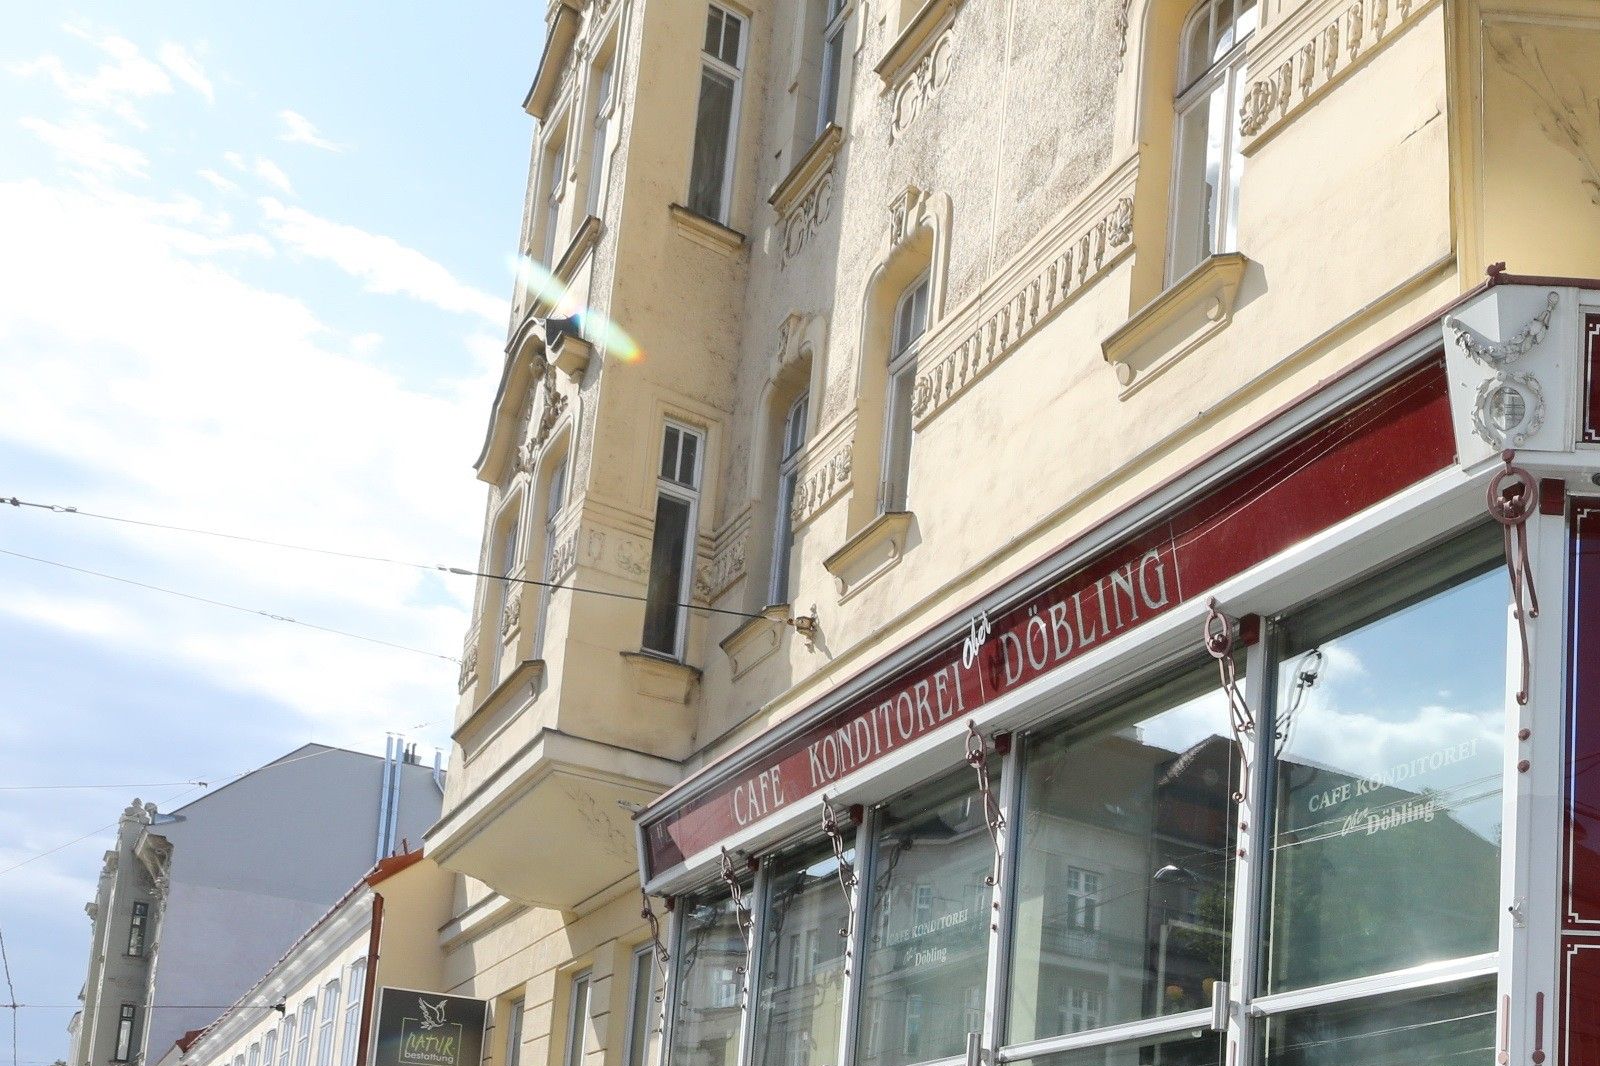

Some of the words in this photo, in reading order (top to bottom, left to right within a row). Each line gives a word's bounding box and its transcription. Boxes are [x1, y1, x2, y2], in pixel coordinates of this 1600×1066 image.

[1000, 548, 1169, 688] DÖBLING
[733, 765, 784, 826] CAFE
[807, 661, 965, 788] KONDITOREI
[1308, 783, 1351, 813] CAFE
[1355, 738, 1479, 797] KONDITOREI
[1366, 799, 1436, 836] Döbling
[911, 908, 969, 939] KONDITOREI
[914, 946, 948, 967] Döbling
[404, 1050, 454, 1064] bestattung
